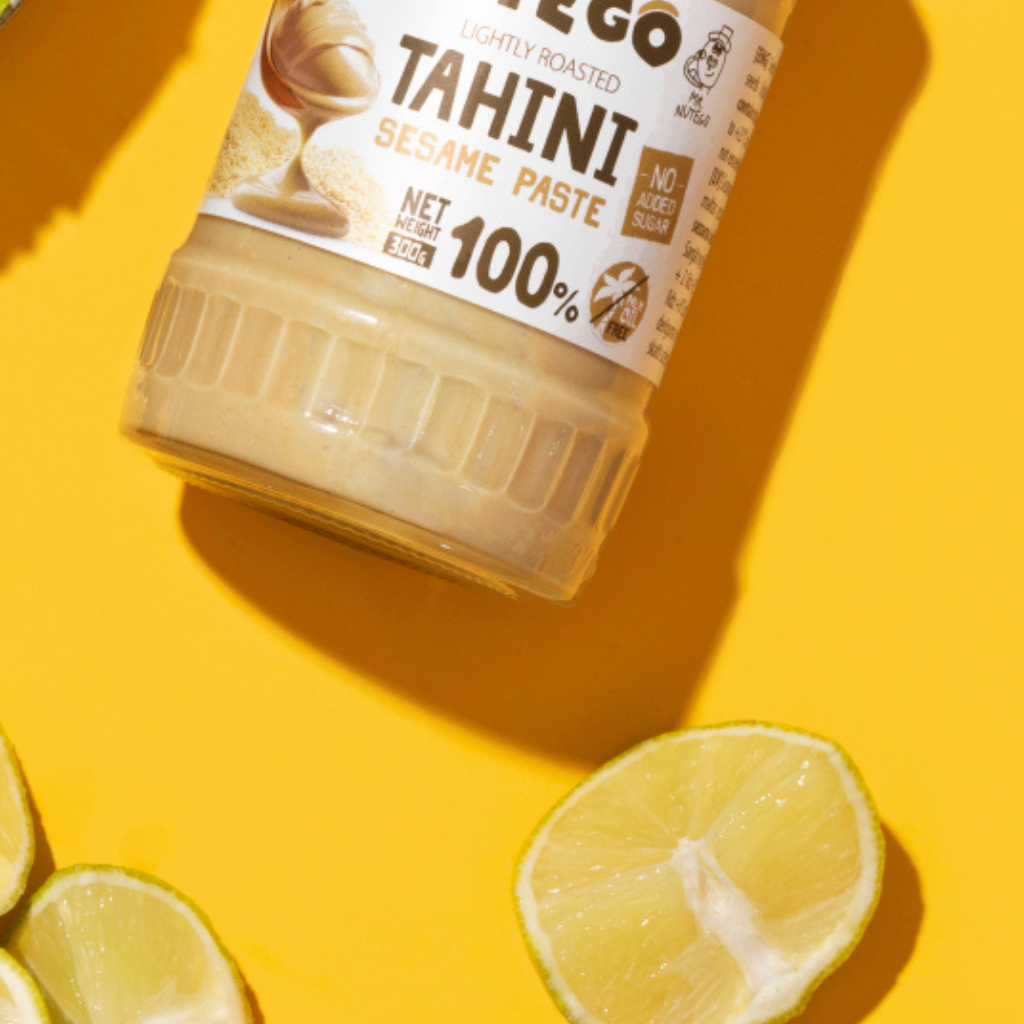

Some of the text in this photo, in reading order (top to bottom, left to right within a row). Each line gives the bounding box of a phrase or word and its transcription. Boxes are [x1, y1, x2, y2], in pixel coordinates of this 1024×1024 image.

[460, 19, 621, 94] LIGHTLY ROASTED
[392, 34, 638, 187] TAHINI
[674, 104, 711, 127] NUTEGO
[374, 117, 606, 228] SESAME PASTE
[650, 164, 677, 193] NO
[400, 186, 451, 224] NET
[636, 193, 676, 215] ADDED
[394, 214, 442, 242] WEIGHT
[632, 211, 671, 235] SUGAR
[451, 216, 579, 323] 100%
[606, 320, 630, 342] FREE
